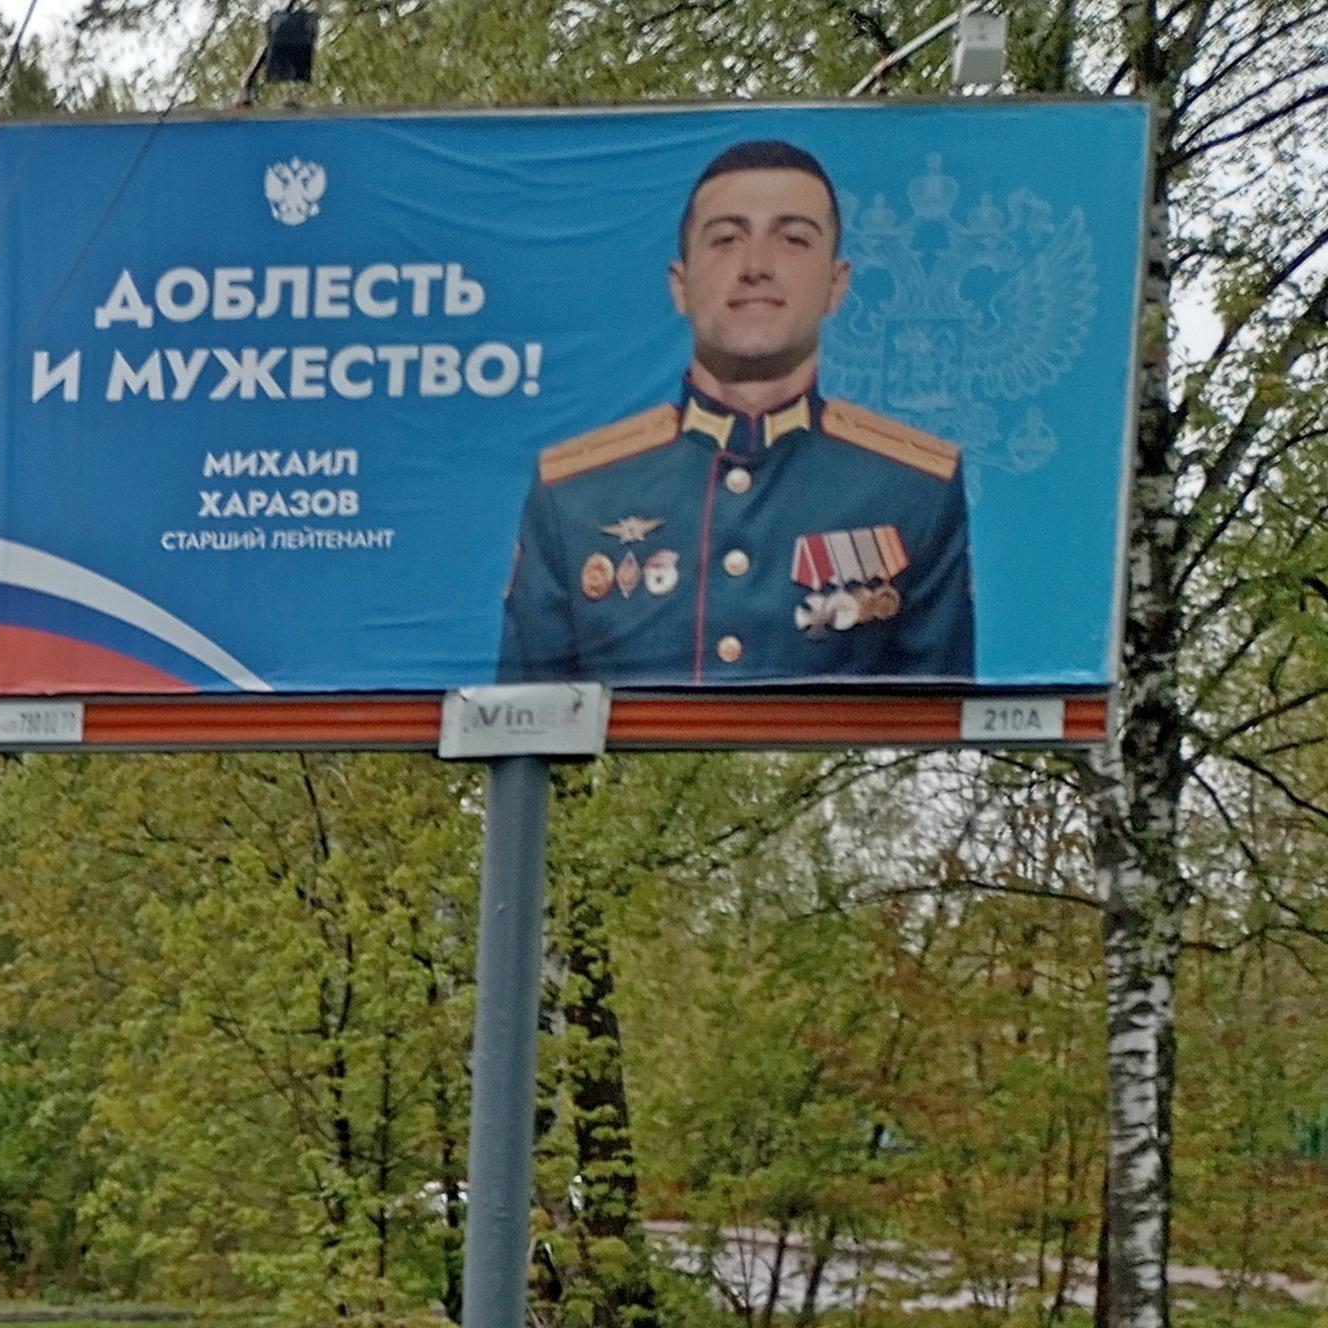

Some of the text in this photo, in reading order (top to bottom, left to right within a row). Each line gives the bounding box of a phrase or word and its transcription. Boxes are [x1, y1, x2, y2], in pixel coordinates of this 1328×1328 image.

[94, 263, 486, 330] ДОБЛЕСТЬ
[31, 340, 543, 404] И МУЖЕСТВО!
[201, 448, 359, 478] МИХАИЛ
[197, 489, 360, 518] ХАРАЗОВ
[160, 525, 396, 551] СТАРШИЙ ЛЕЙТЕНАНТ
